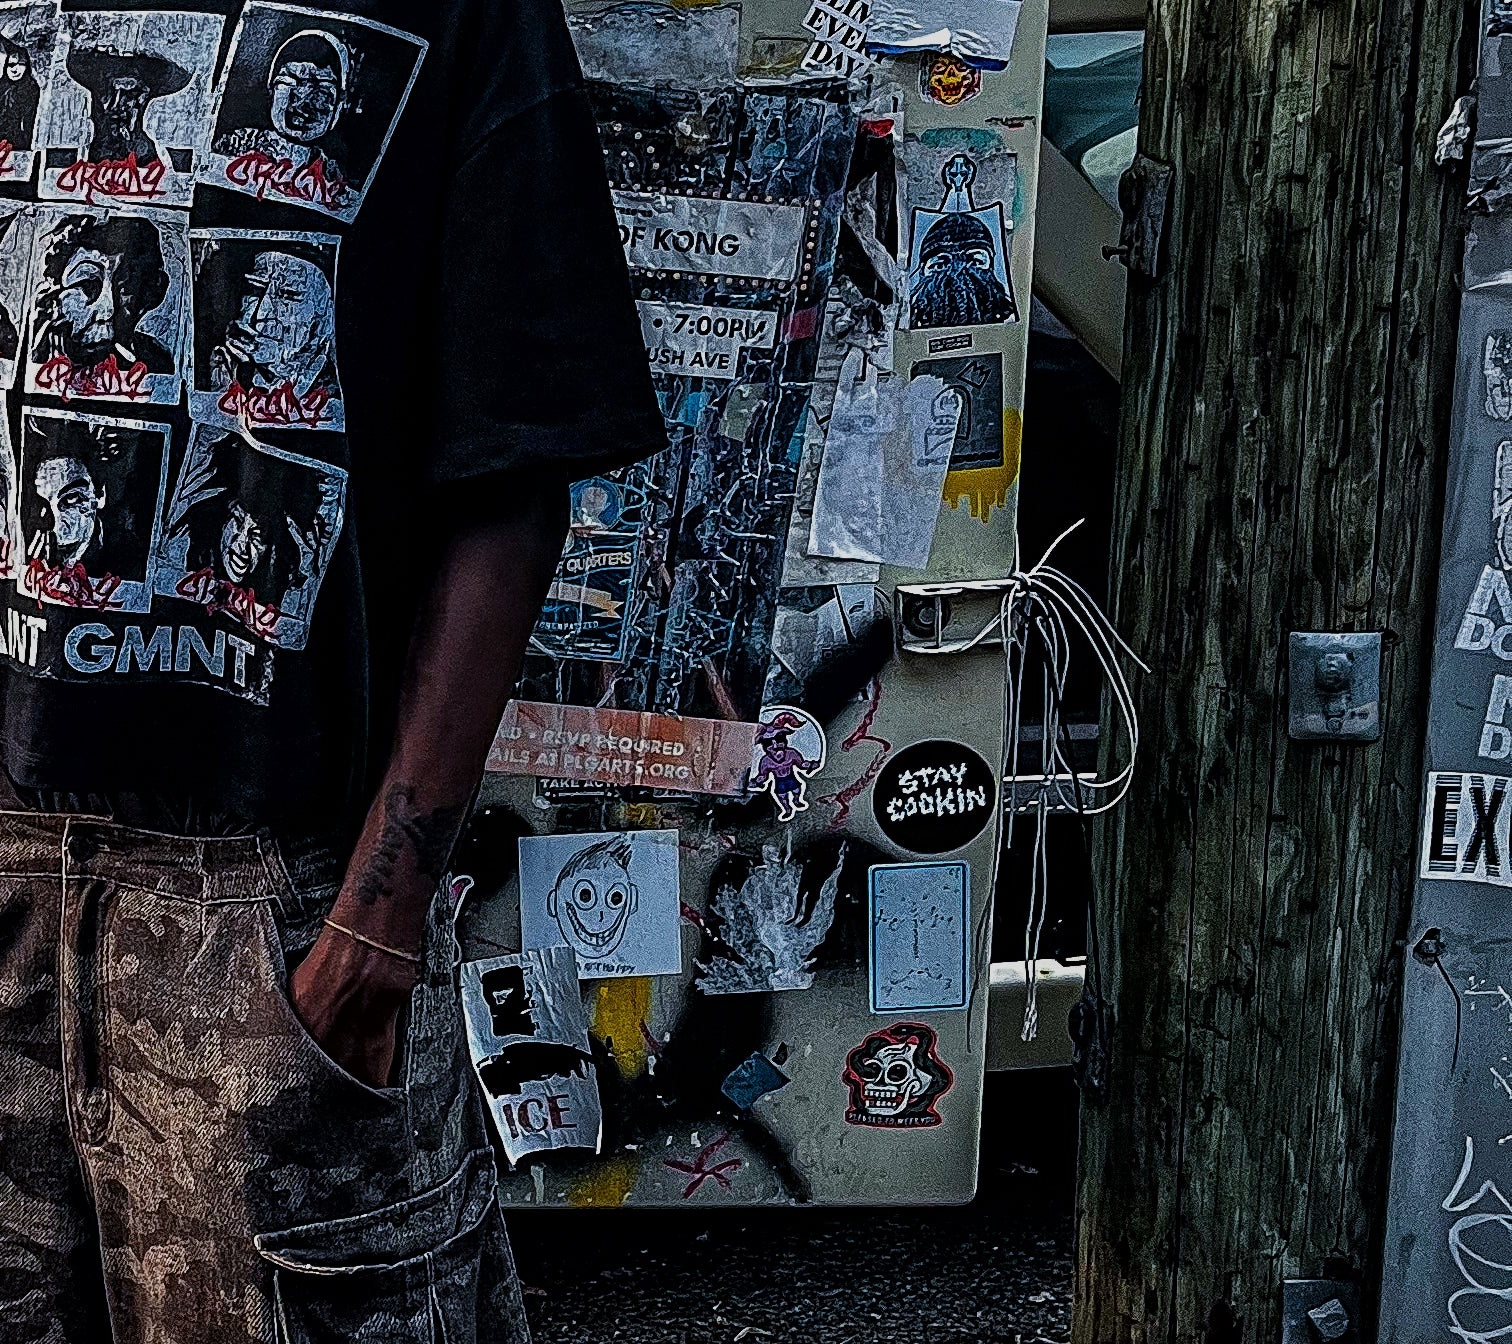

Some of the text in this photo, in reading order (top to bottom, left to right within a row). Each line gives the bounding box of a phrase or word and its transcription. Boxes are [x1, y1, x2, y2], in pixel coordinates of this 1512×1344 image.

[653, 227, 740, 257] KONG
[672, 313, 768, 339] 7:00PM
[689, 351, 730, 370] AVE
[566, 551, 632, 574] QUARTERS
[64, 622, 255, 688] GMNT
[898, 762, 967, 794] STAY
[886, 785, 986, 822] COOKIN
[1429, 772, 1512, 872] EX
[502, 1094, 578, 1140] ICE
